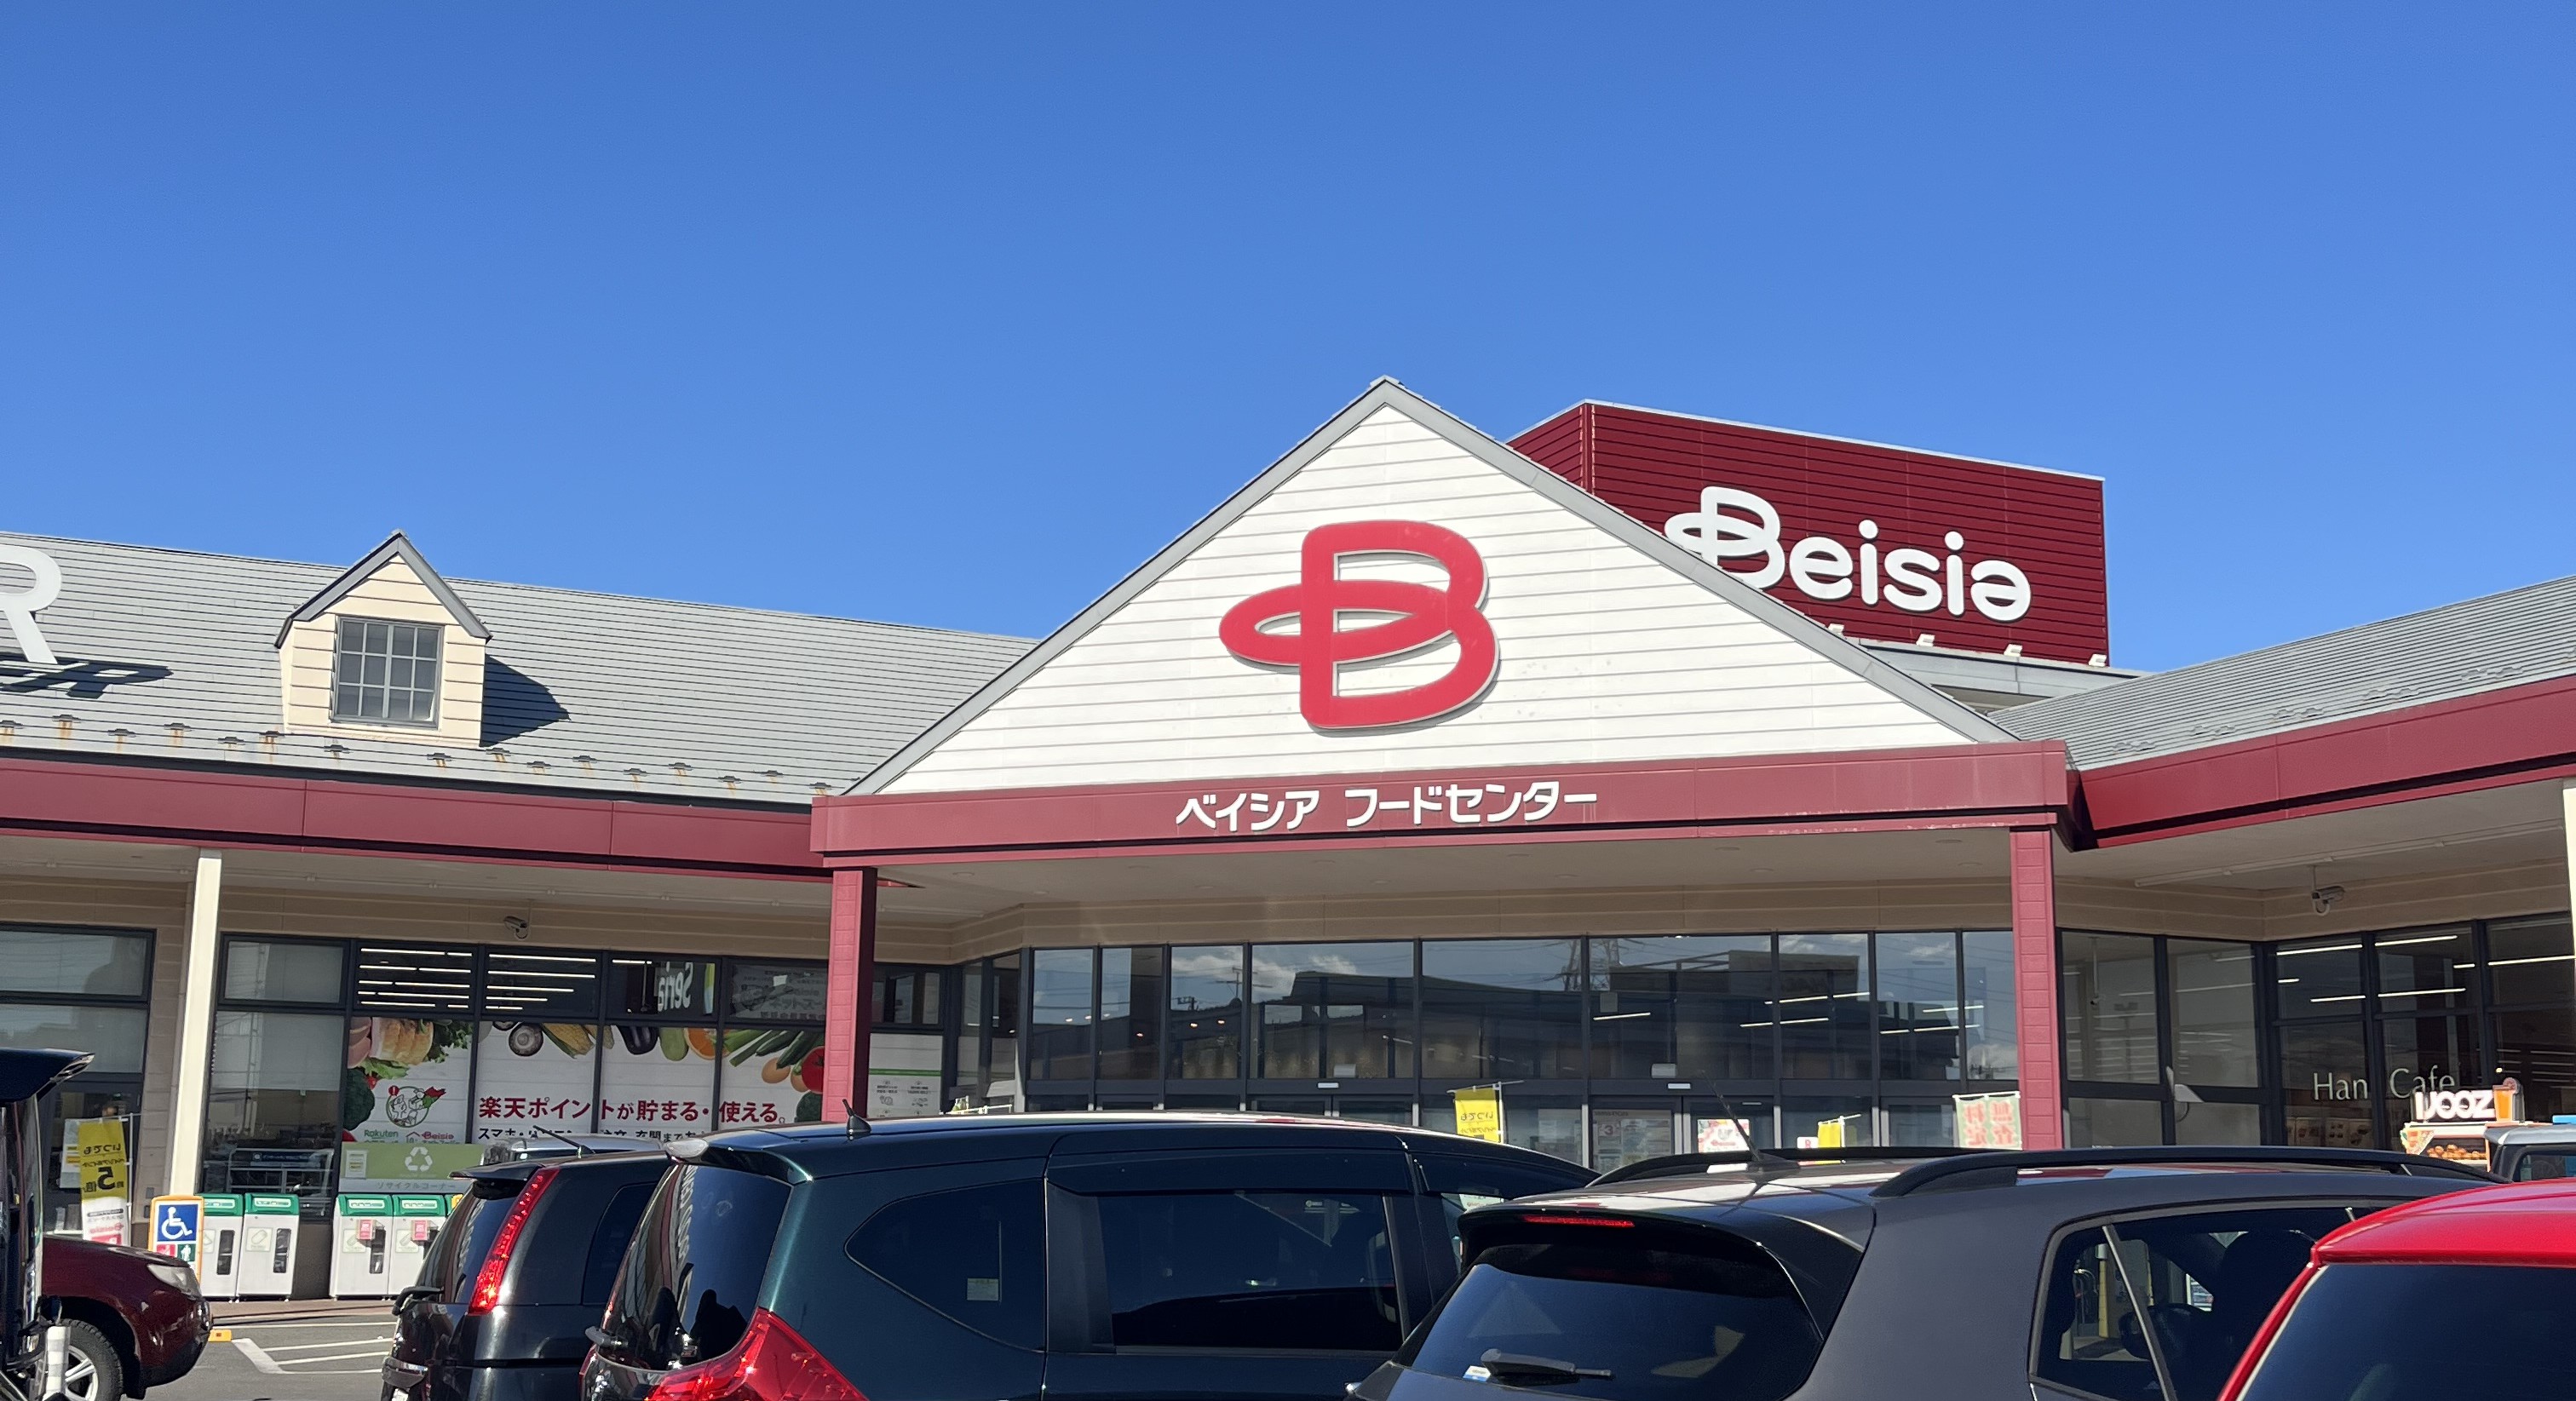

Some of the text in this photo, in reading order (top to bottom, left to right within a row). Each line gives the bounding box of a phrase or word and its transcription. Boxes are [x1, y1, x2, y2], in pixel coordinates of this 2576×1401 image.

[1664, 485, 2033, 622] Beisia
[1219, 520, 1497, 727] B
[1176, 781, 1598, 832] ベイシア フードセンター
[364, 1129, 399, 1139] Rakuten
[377, 1181, 457, 1191] リサイクルコーナー
